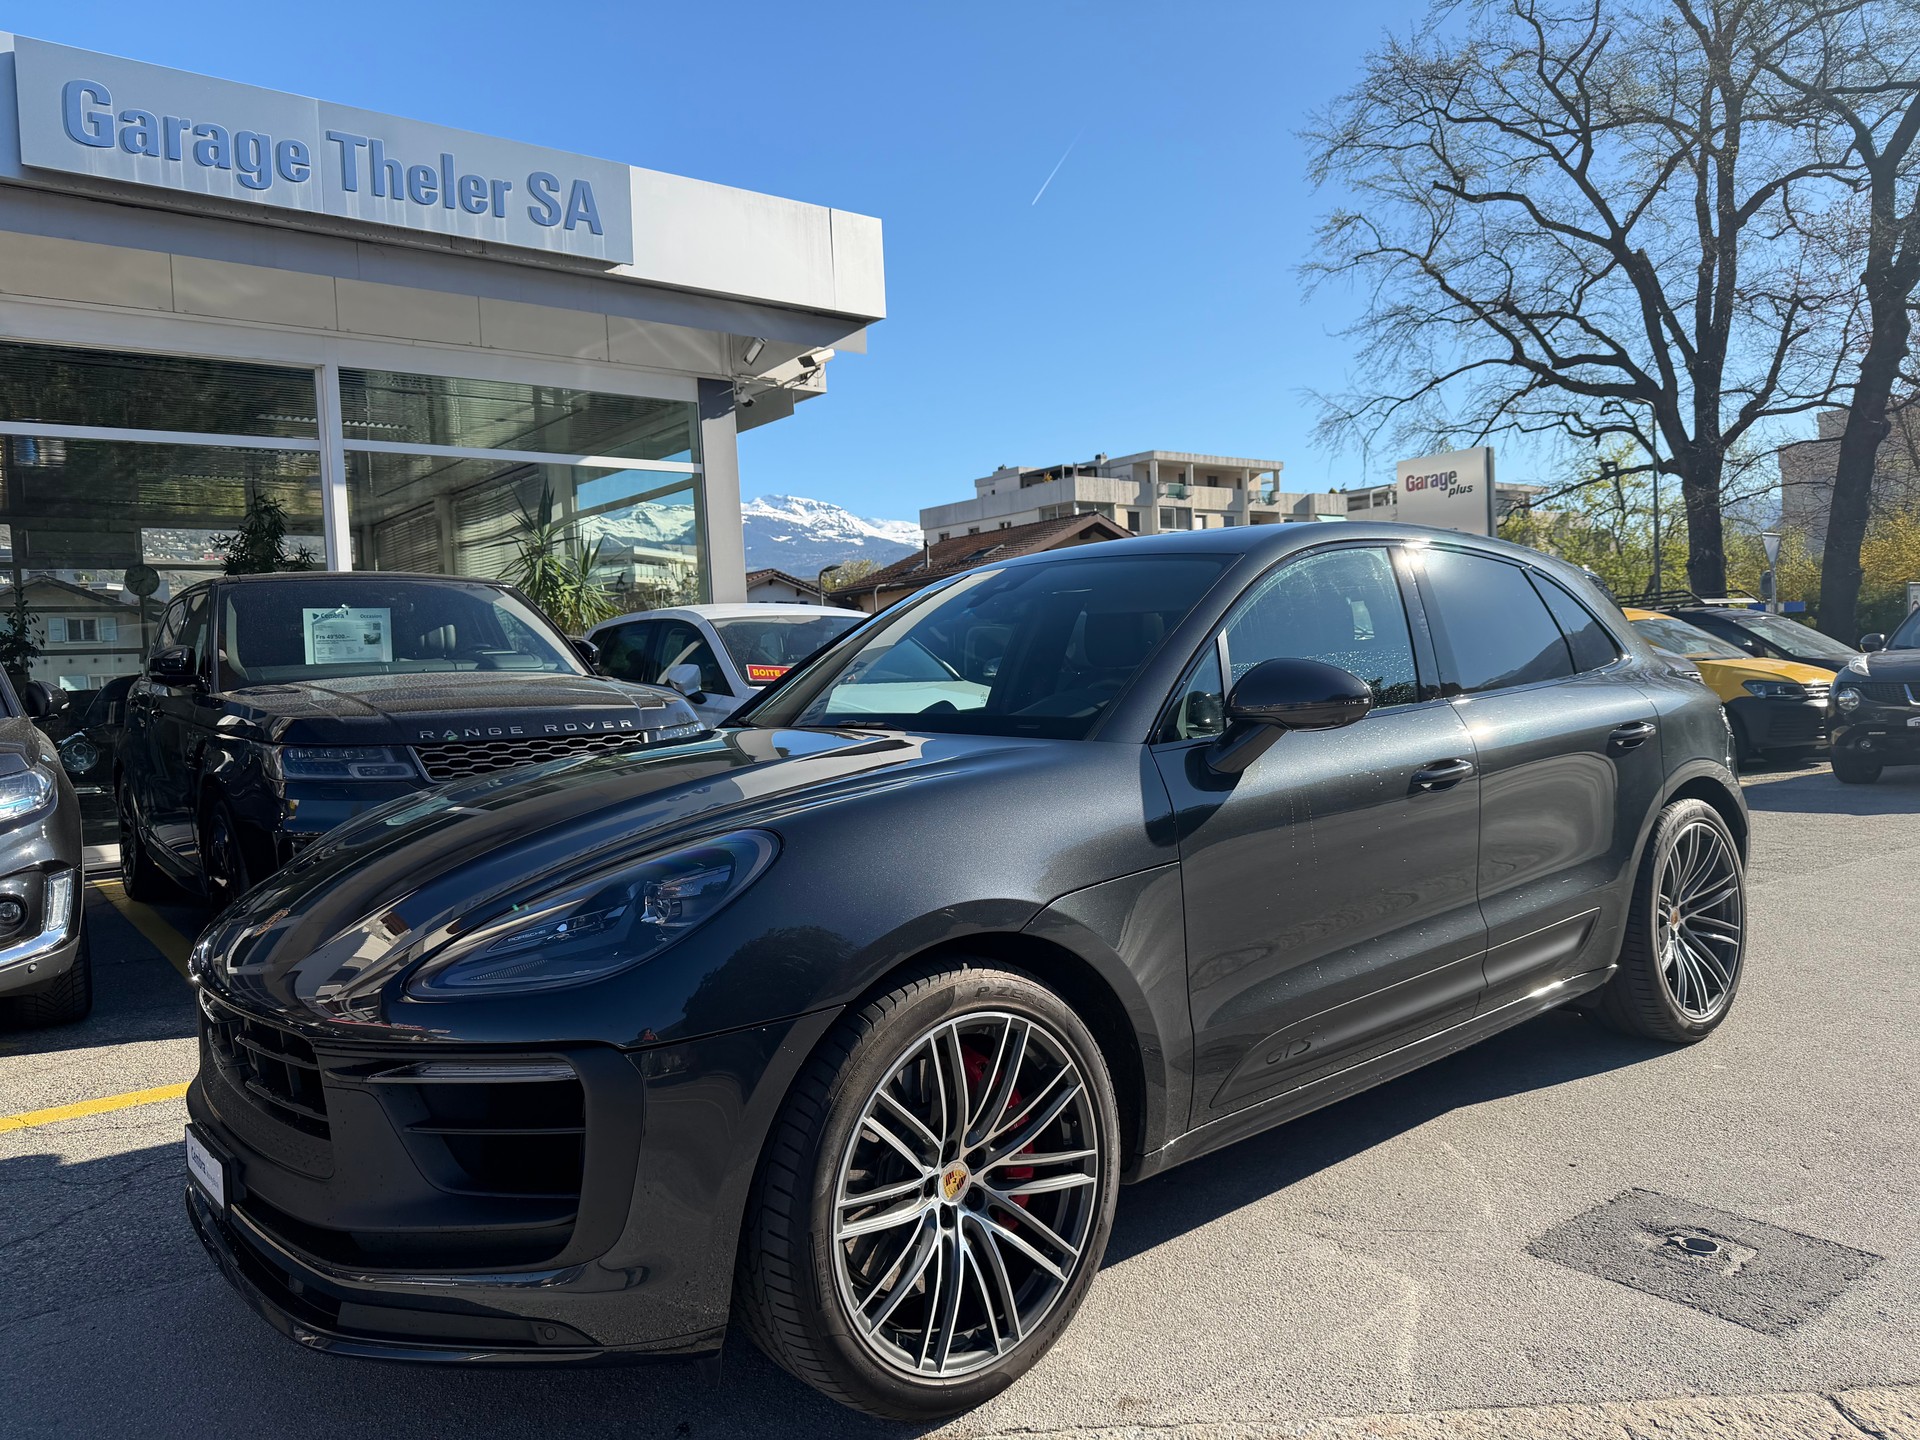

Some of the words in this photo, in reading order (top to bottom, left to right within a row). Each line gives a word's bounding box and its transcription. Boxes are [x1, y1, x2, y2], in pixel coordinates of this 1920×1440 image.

[62, 79, 310, 190] Garage
[326, 130, 512, 219] Theler
[526, 171, 604, 236] SA
[1405, 470, 1458, 492] Garage
[1448, 484, 1473, 498] plus
[752, 668, 781, 677] BOITE
[419, 726, 524, 739] RANGE
[544, 719, 633, 733] ROVER
[1265, 1034, 1311, 1065] GTS
